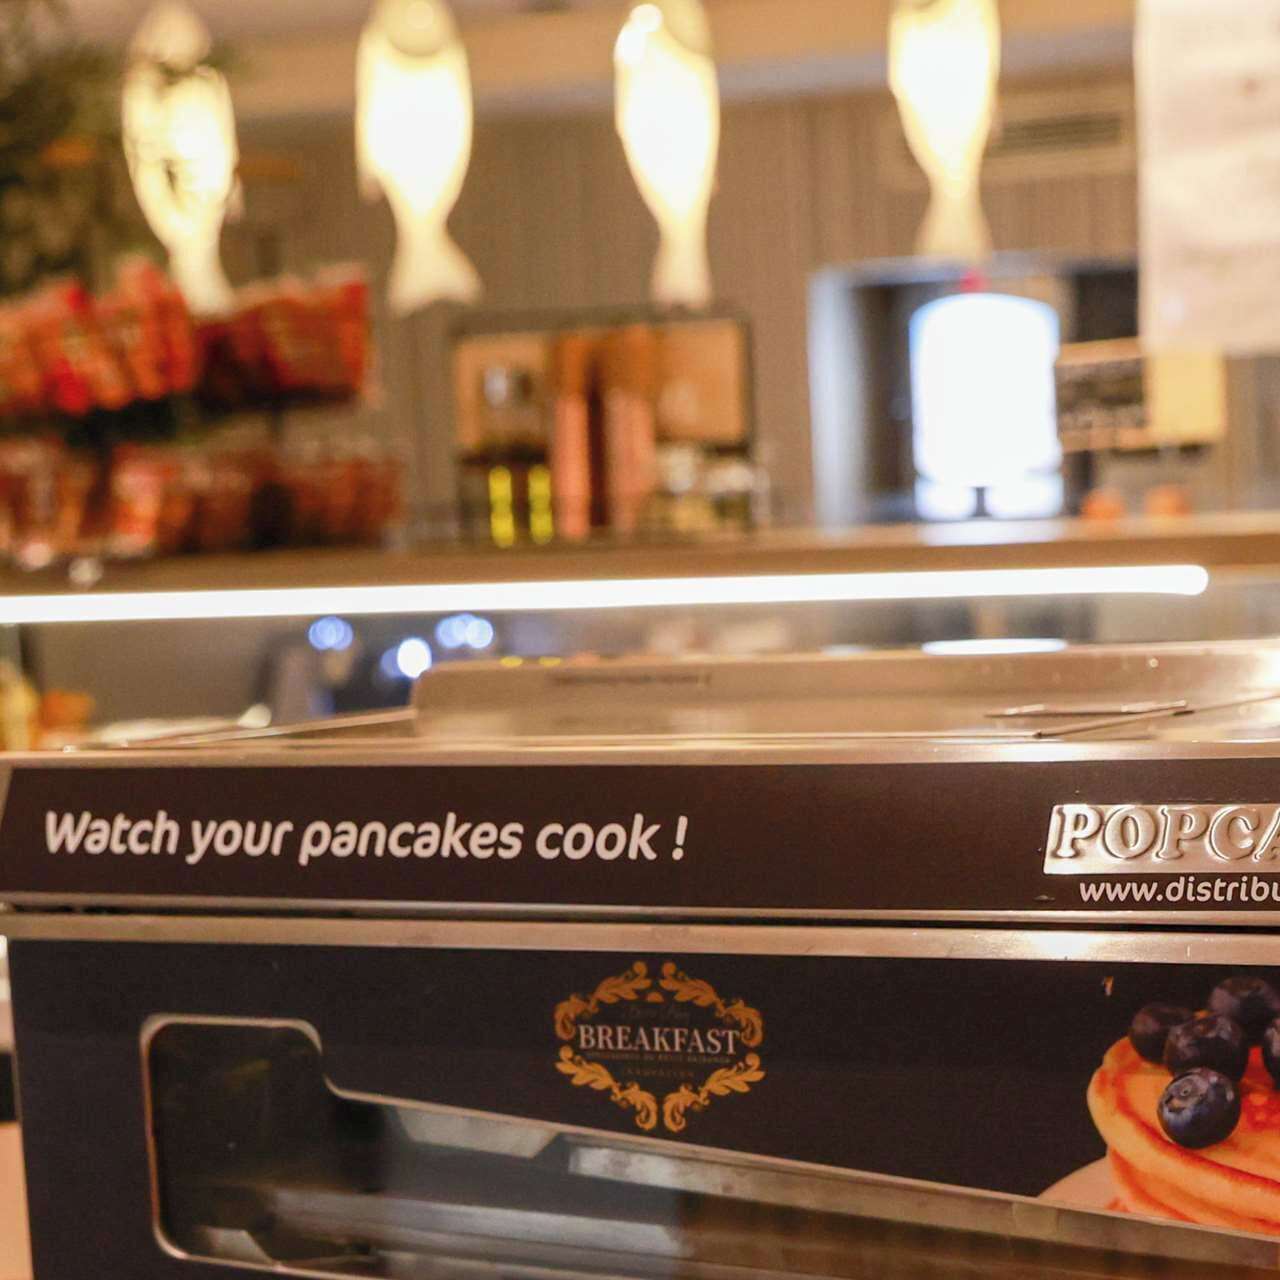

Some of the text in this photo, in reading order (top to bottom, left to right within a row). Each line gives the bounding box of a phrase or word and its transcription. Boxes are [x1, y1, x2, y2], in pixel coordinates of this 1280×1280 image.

[44, 810, 181, 856] Watch
[185, 820, 295, 866] your
[298, 812, 524, 867] pancakes
[535, 812, 662, 862] cook
[578, 1023, 742, 1055] BREAKFAST
